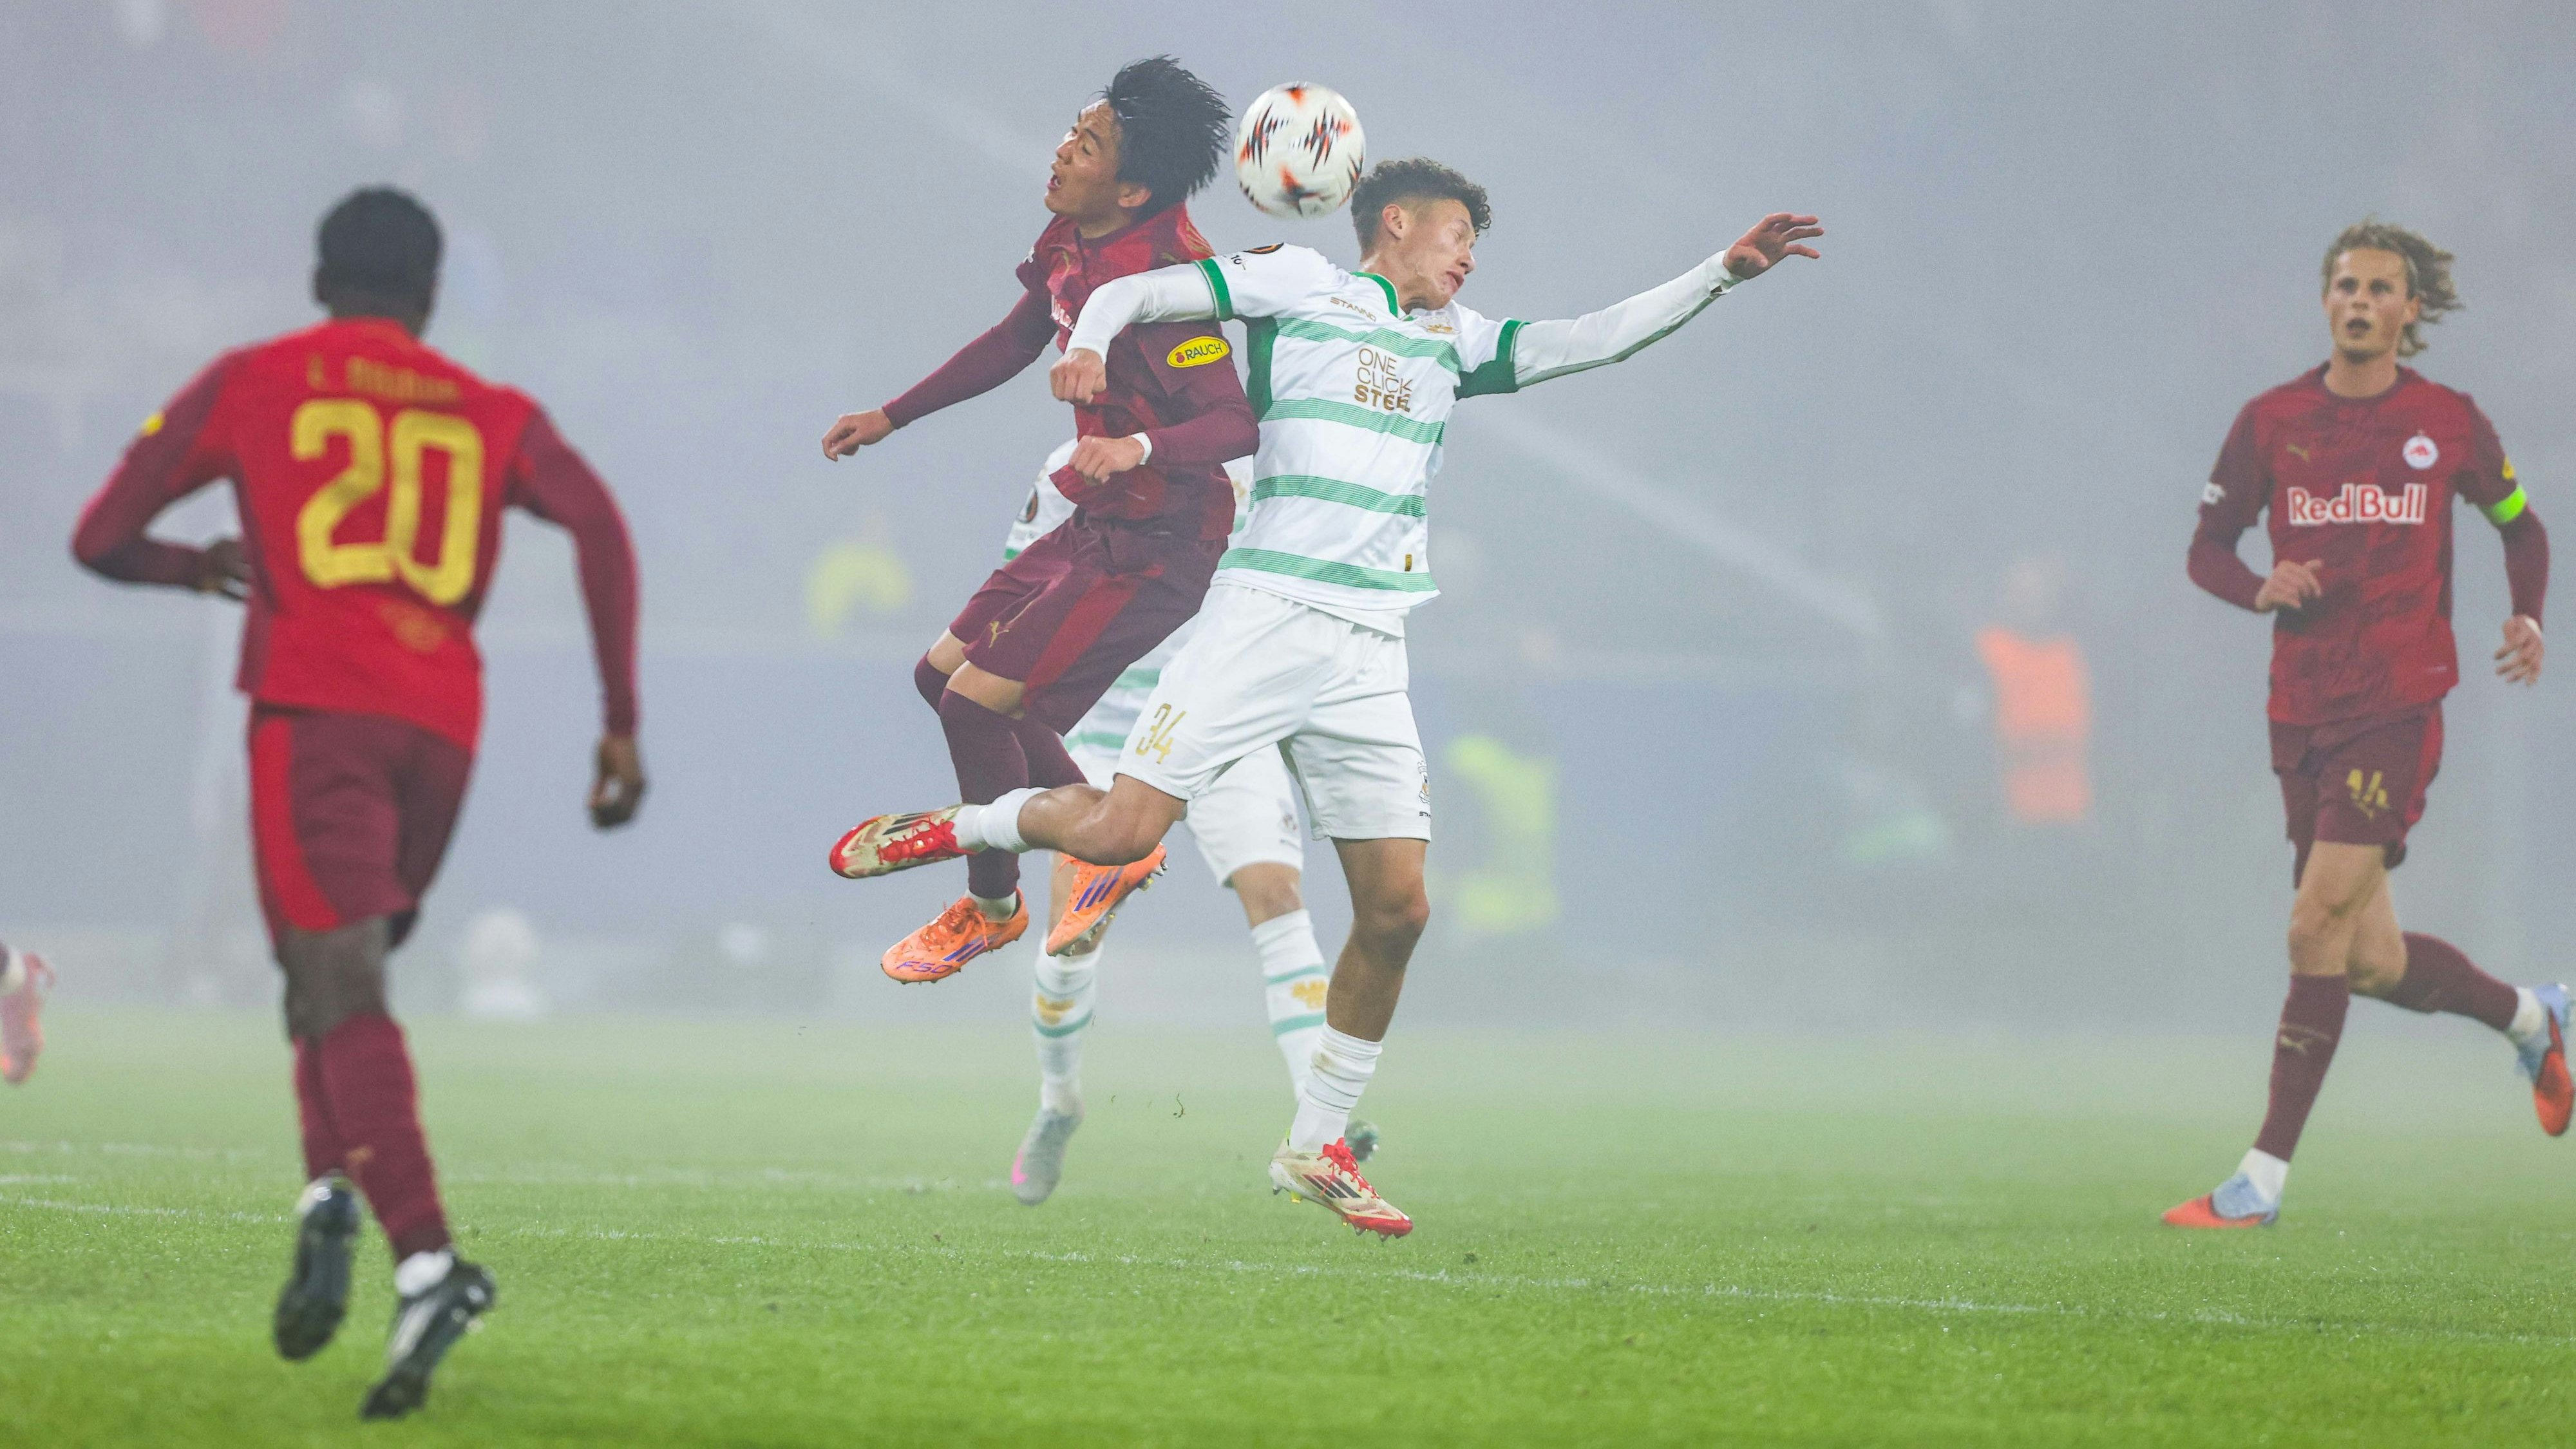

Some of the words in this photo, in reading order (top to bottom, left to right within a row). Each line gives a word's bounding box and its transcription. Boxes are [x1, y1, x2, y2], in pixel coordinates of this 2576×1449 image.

[1185, 343, 1223, 360] RAUCH
[1359, 348, 1397, 377] ONE
[1357, 367, 1413, 394] CLICK
[290, 398, 483, 605] 20
[2287, 483, 2354, 526] Red
[2356, 483, 2427, 525] Bull
[1135, 703, 1186, 764] 34
[896, 960, 952, 973] F50
